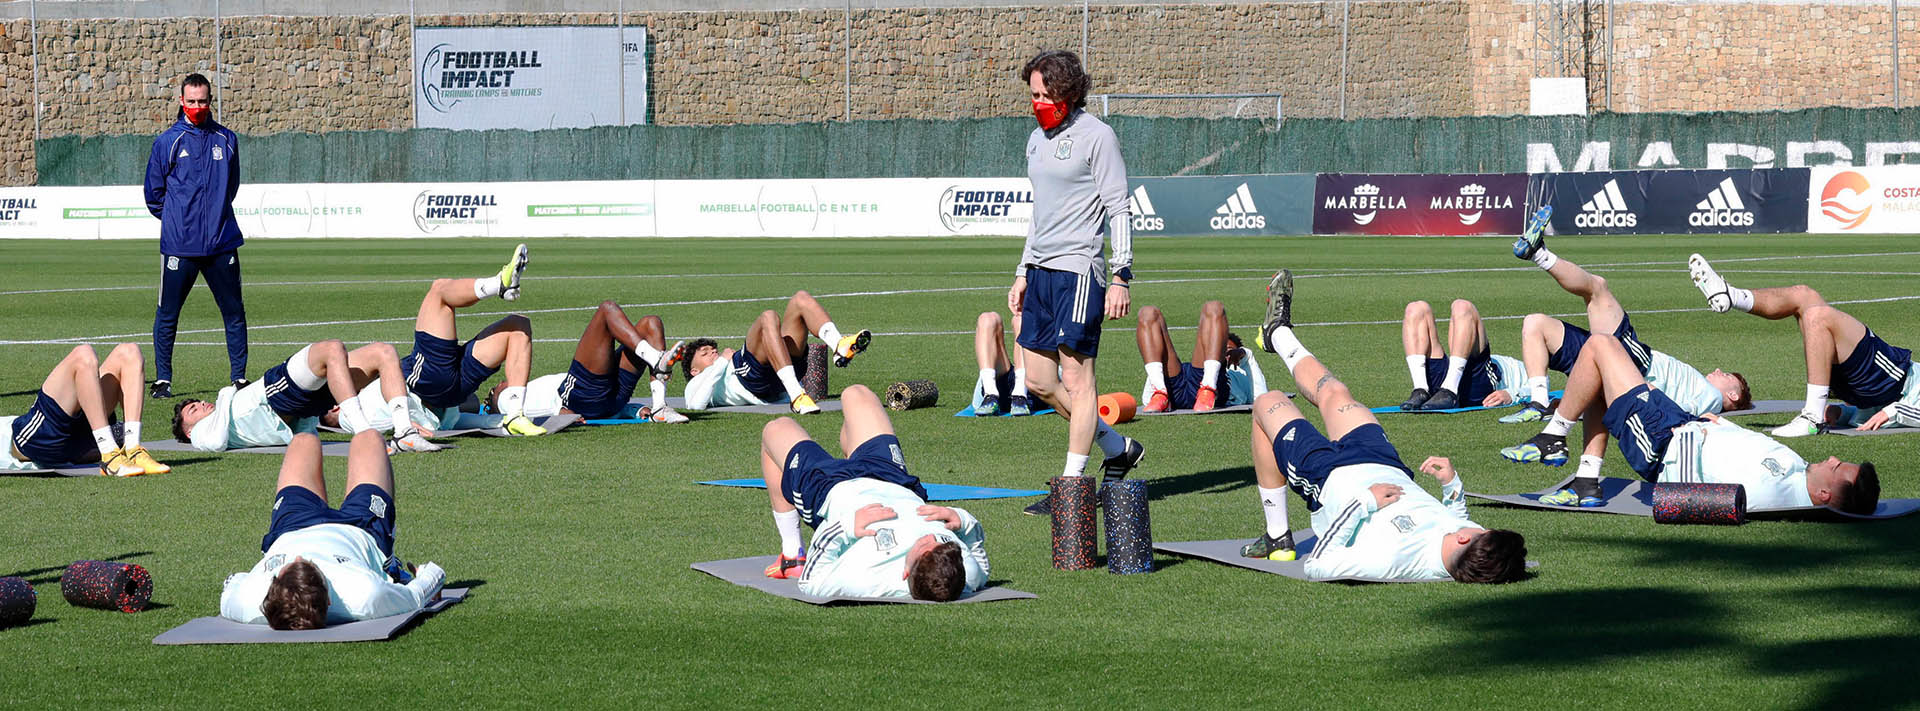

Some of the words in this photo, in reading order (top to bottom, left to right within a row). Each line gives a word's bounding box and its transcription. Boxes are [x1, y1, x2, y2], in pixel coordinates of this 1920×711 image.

[443, 51, 542, 69] FOOTBALL
[440, 70, 515, 88] IMPACT
[441, 89, 474, 98] TRAINING
[509, 88, 543, 97] MATCHES
[427, 195, 498, 206] FOOTBALL
[954, 191, 1034, 203] FOOTBALL
[1324, 196, 1407, 209] MARBELLA
[1430, 195, 1514, 209] MARBELLA
[263, 207, 310, 216] FOOTBALL
[312, 206, 362, 216] CENTER
[426, 207, 478, 219] IMPACT
[700, 203, 757, 213] MARBELLA
[760, 203, 816, 213] FOOTBALL
[819, 203, 878, 213] CENTER
[953, 204, 1012, 217] IMPACT
[1210, 212, 1266, 230] adidas
[1575, 209, 1637, 228] adidas
[1688, 208, 1754, 227] adidas
